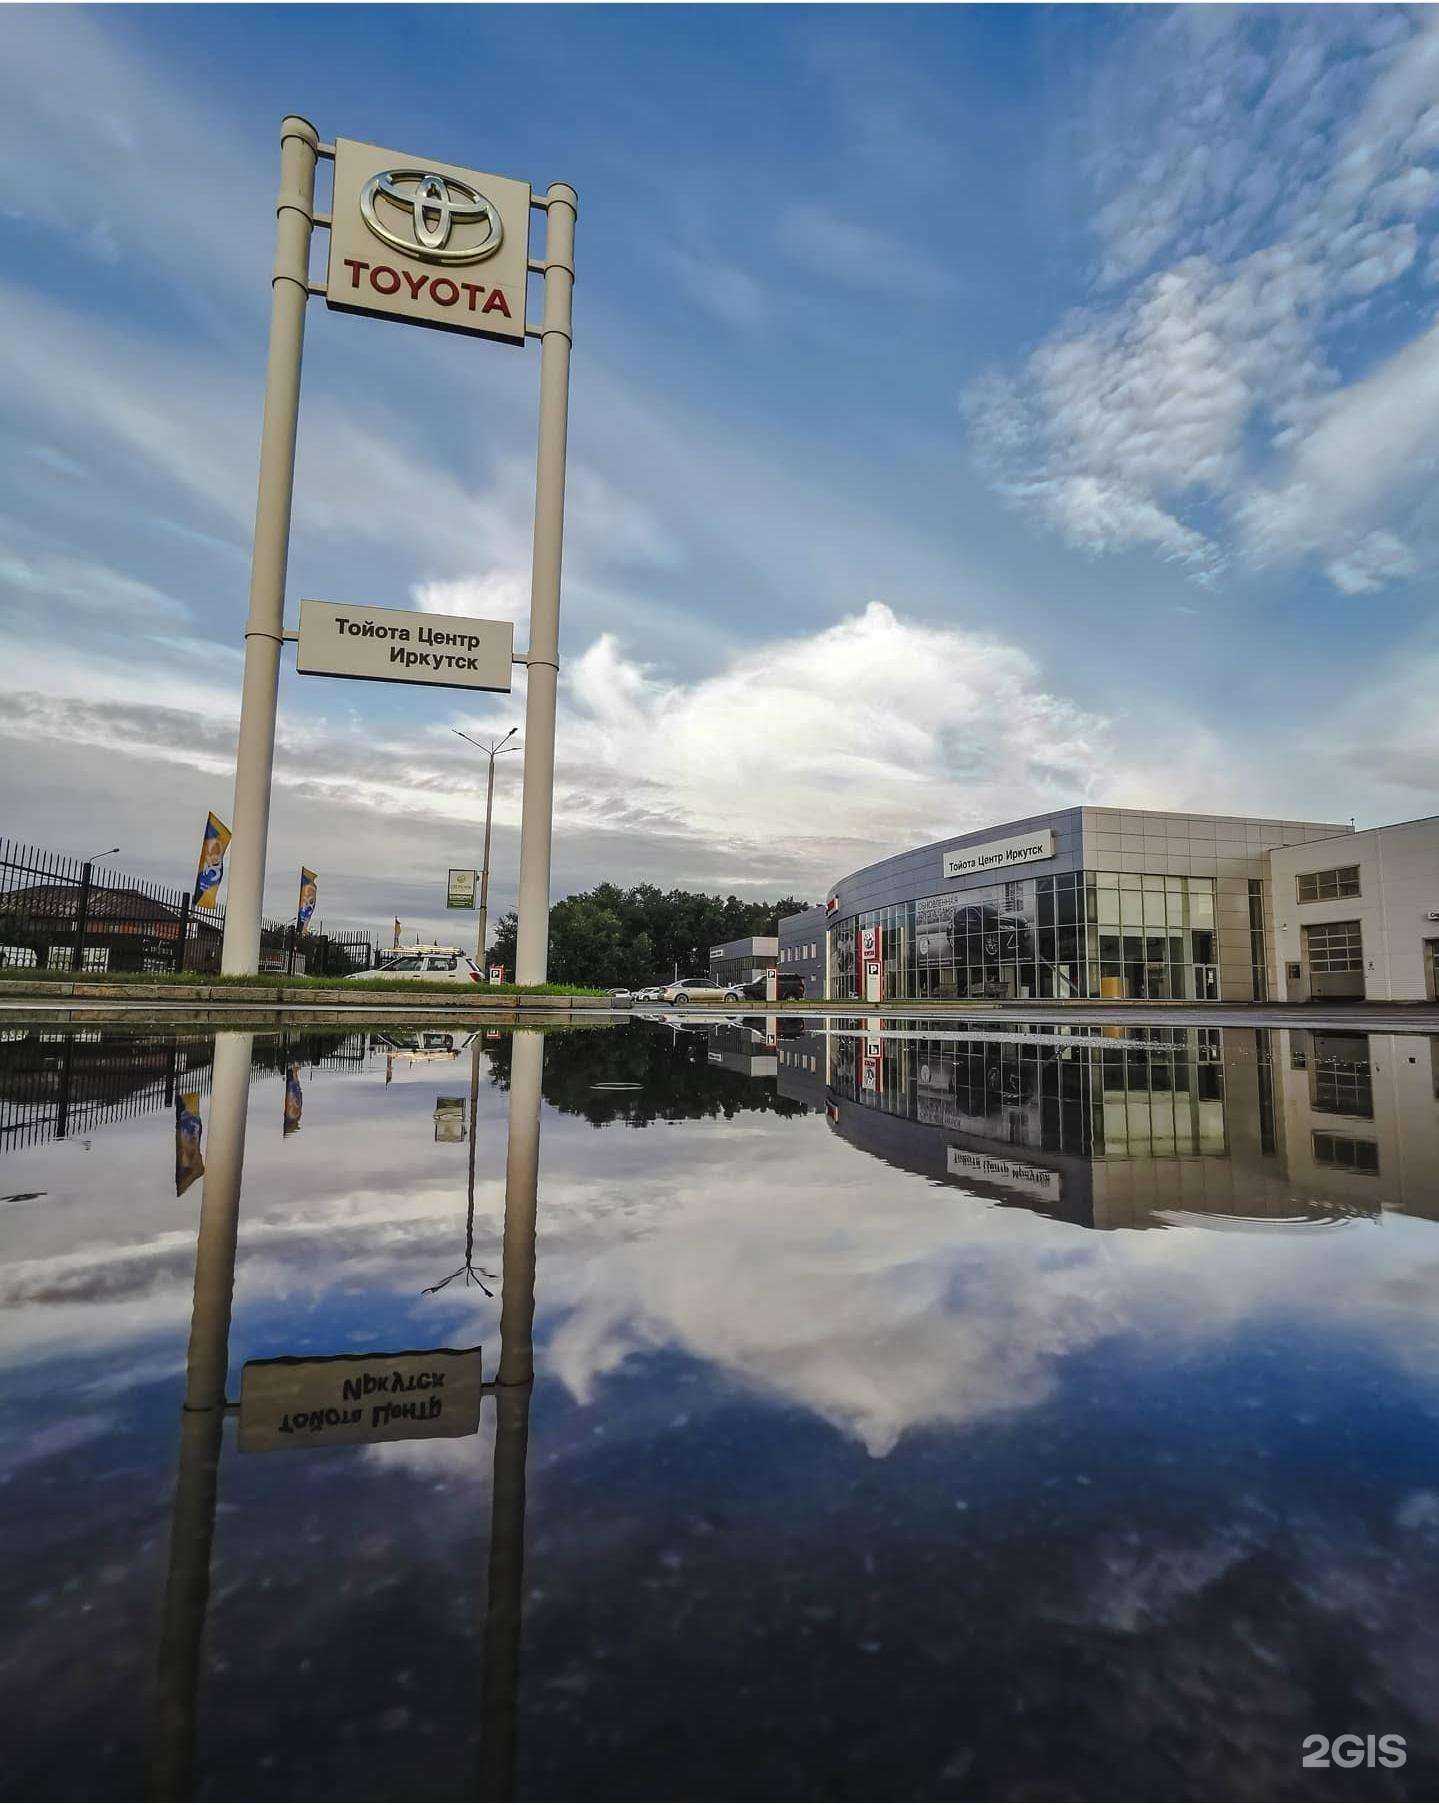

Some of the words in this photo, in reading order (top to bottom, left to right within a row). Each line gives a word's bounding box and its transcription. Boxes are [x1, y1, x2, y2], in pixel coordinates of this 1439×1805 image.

[344, 258, 512, 318] TOYOTA
[335, 618, 410, 641] Тойота
[418, 627, 480, 651] Центр
[390, 646, 478, 670] Иркутск
[949, 859, 976, 871] Тойота
[978, 854, 1003, 866] Центр
[1005, 844, 1043, 861] Иркутск
